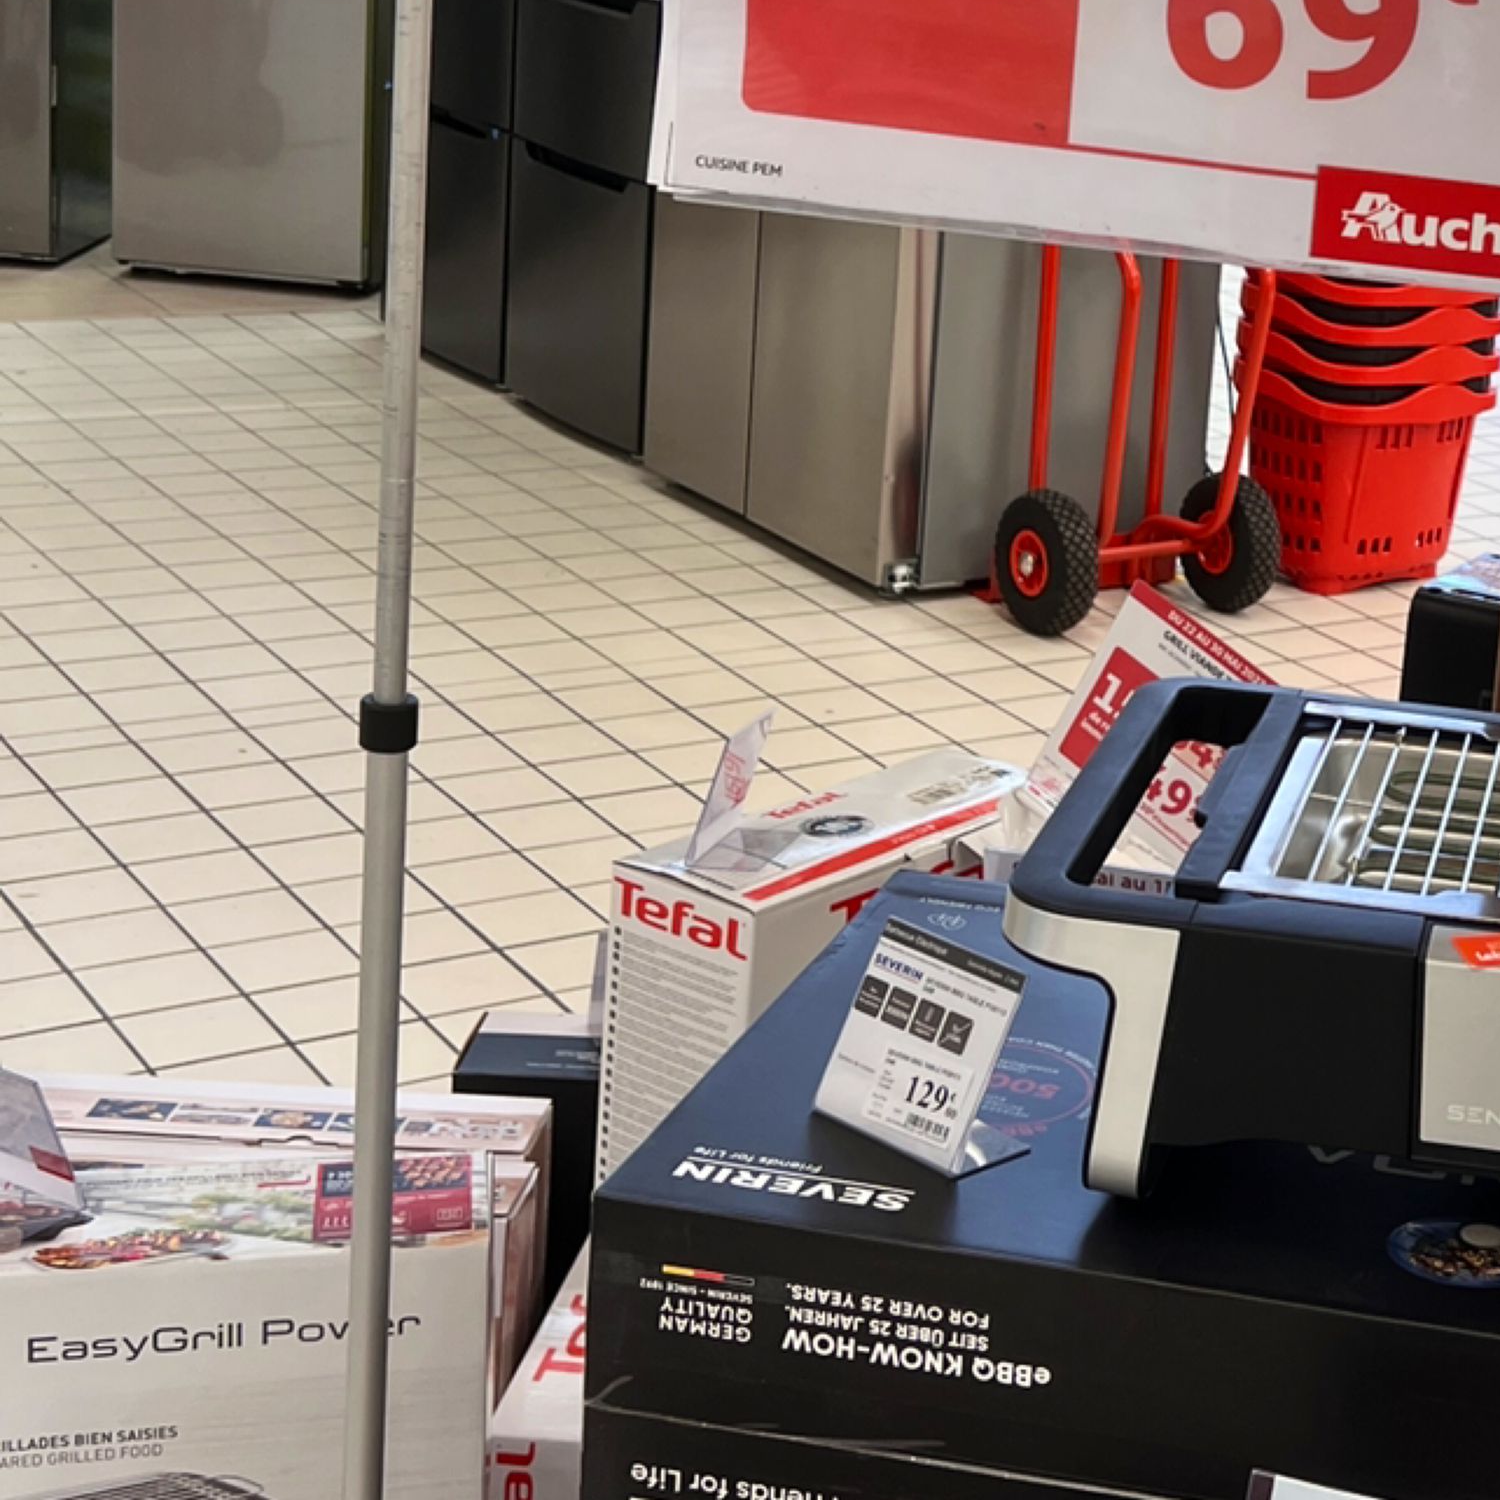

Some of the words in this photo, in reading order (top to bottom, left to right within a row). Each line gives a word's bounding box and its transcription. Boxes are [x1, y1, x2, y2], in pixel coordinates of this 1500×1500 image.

[695, 154, 749, 174] CUISINE
[1121, 873, 1147, 892] au
[613, 875, 748, 961] Tefal
[672, 1159, 912, 1212] SEVERIN
[785, 1282, 855, 1309] YEARS.
[860, 1293, 883, 1313] 25
[660, 1297, 753, 1323] QUALITY
[785, 1304, 862, 1334] JAHREN.
[889, 1299, 943, 1325] OVER
[949, 1307, 990, 1329] FOR
[658, 1314, 752, 1342] GERMAN
[868, 1318, 890, 1338] 25
[895, 1322, 944, 1349] ÜBER
[949, 1329, 989, 1350] SEIT
[27, 1322, 243, 1364] EasyGrill
[782, 1328, 963, 1378] KNOW-HOW
[973, 1360, 1052, 1388] eBBQ
[74, 1430, 113, 1446] BIEN
[116, 1425, 179, 1443] SAISIES
[47, 1447, 116, 1466] GRILLED
[119, 1443, 164, 1460] FOOD
[630, 1463, 681, 1492] Life
[689, 1474, 728, 1499] for
